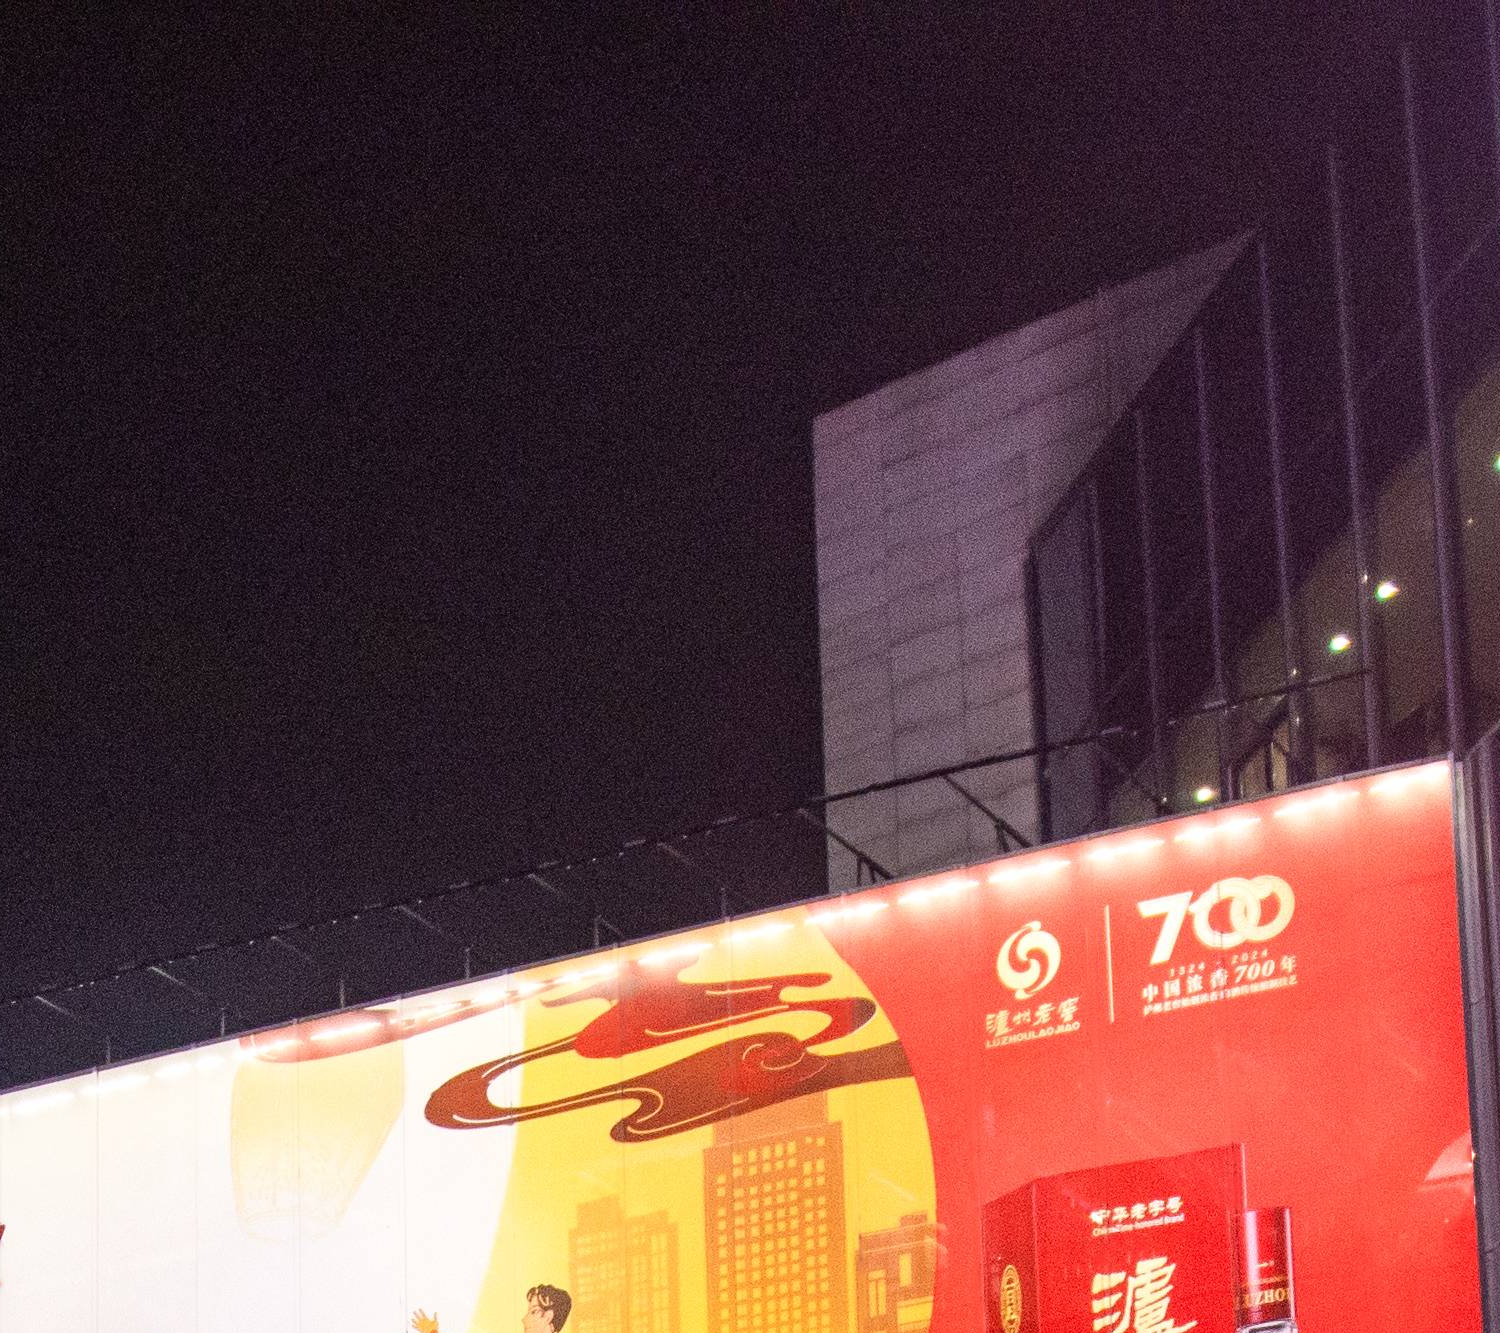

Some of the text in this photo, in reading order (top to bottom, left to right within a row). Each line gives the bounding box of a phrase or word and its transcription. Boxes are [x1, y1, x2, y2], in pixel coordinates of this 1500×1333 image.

[1137, 875, 1296, 965] 700
[985, 996, 1081, 1038] 泸州老窖
